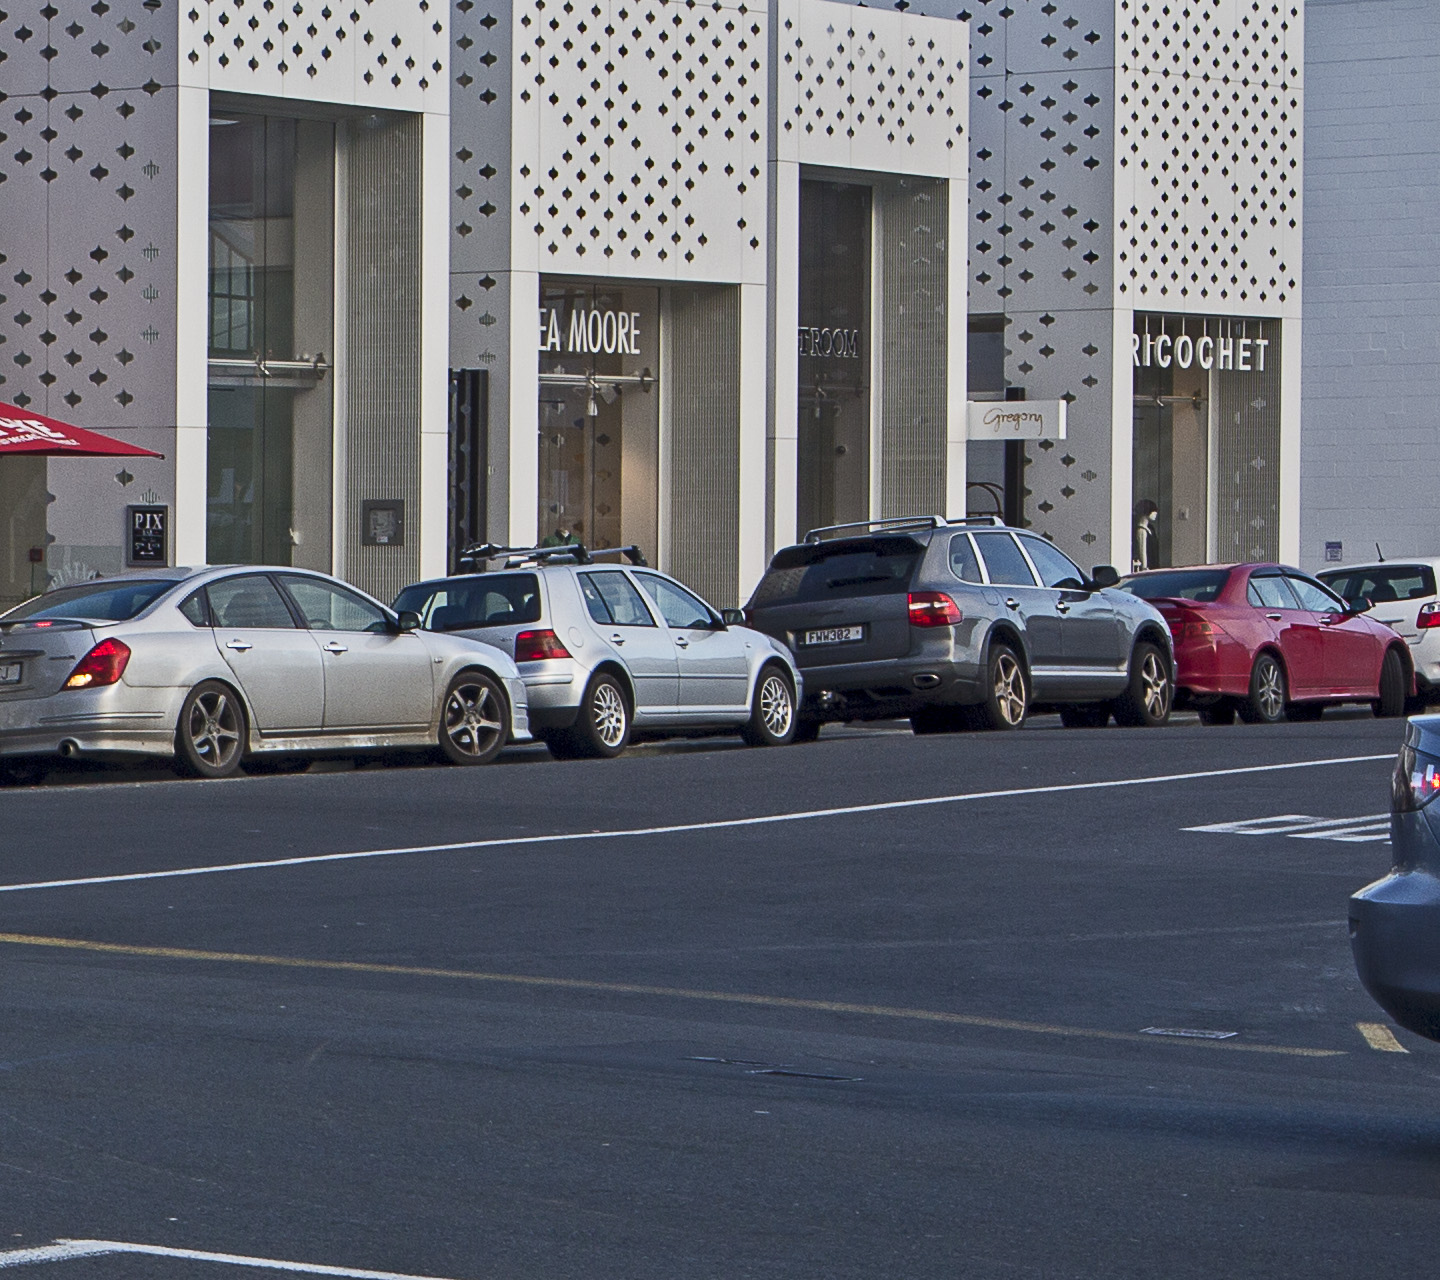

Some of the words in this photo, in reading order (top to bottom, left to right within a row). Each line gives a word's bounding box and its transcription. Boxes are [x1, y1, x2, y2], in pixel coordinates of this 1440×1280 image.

[568, 308, 640, 354] MOORE
[1133, 332, 1268, 371] RICOCHET
[983, 408, 1043, 436] Gregory
[135, 513, 163, 530] PIX
